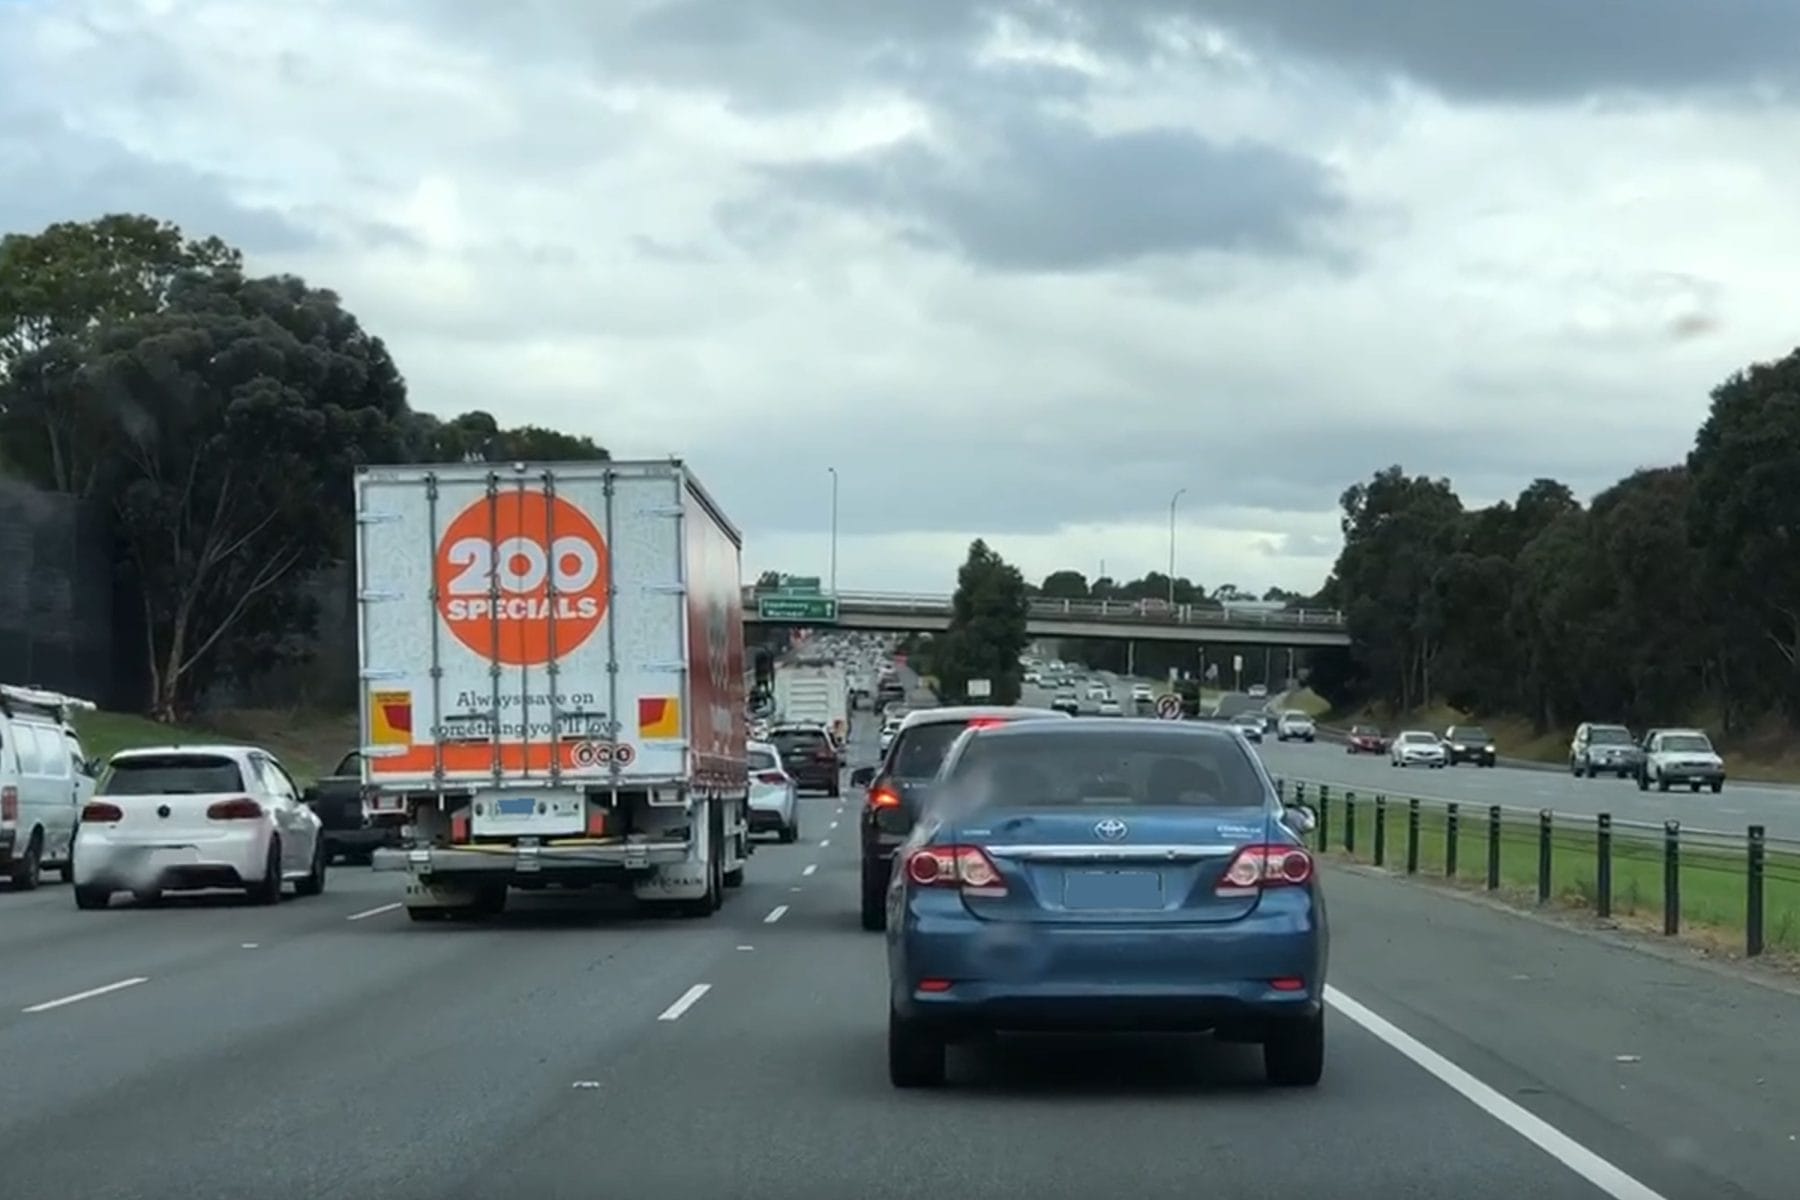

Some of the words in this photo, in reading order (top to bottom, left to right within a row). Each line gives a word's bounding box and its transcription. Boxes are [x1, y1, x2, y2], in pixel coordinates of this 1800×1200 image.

[448, 536, 599, 595] 200
[447, 597, 598, 621] SPECIALS
[525, 694, 567, 707] save
[571, 692, 594, 705] on
[430, 716, 528, 739] somethng
